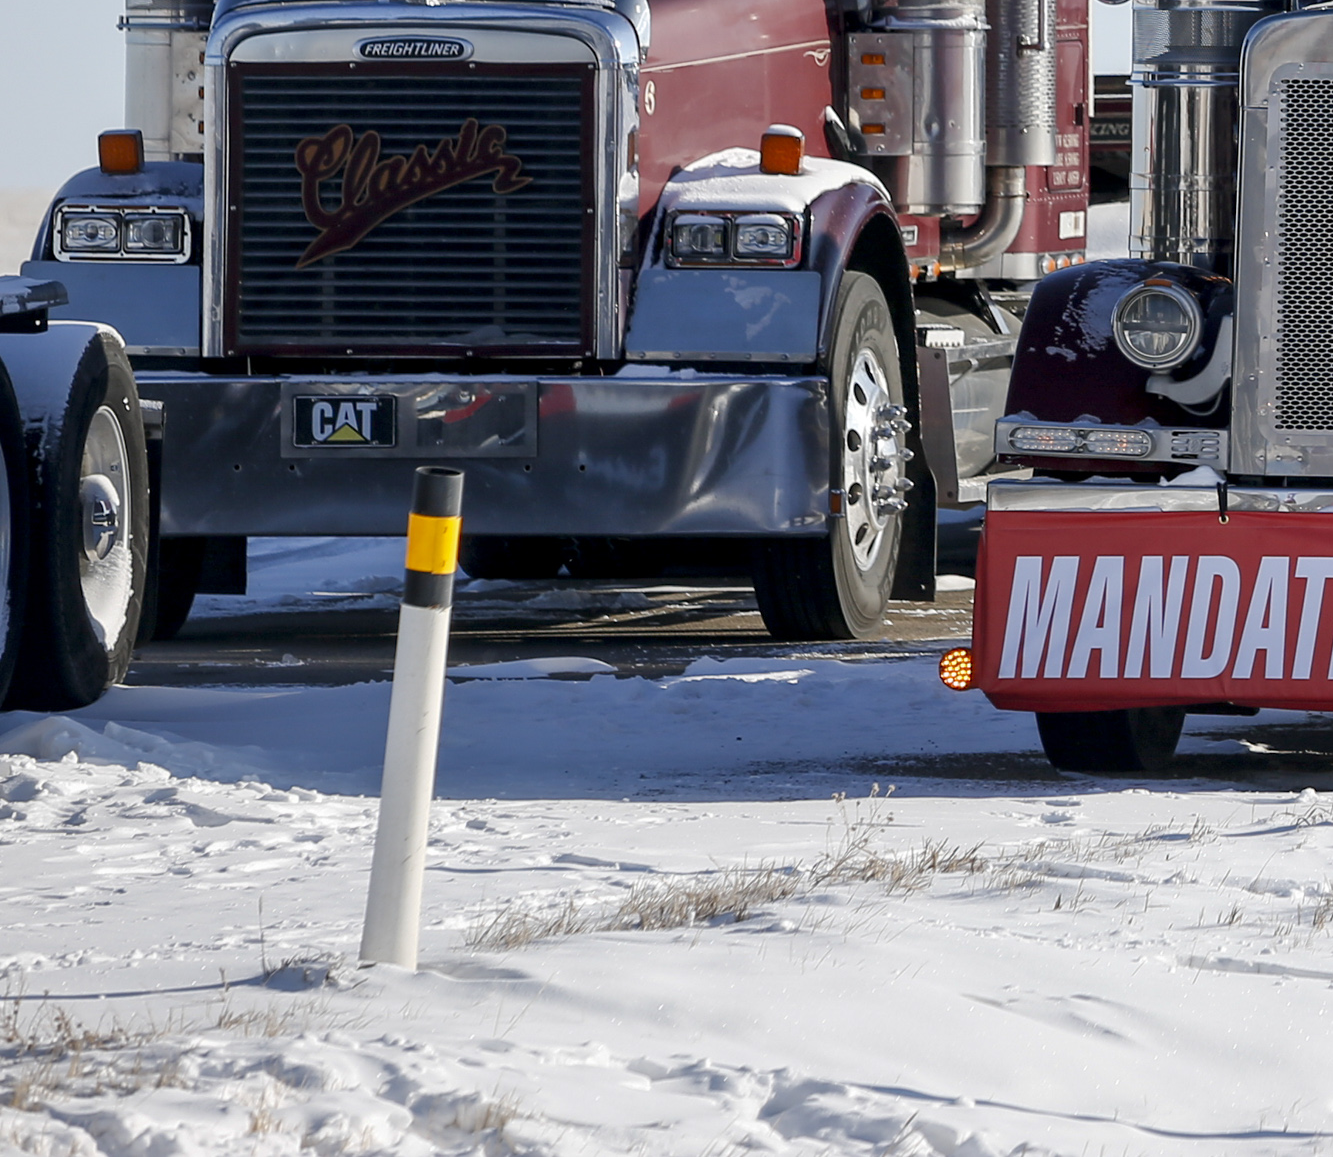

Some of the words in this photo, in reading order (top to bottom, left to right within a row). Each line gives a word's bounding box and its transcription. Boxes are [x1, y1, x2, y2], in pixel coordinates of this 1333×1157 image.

[364, 43, 460, 56] FREIGHTLINER
[294, 118, 533, 250] Classic
[312, 401, 378, 442] CAT
